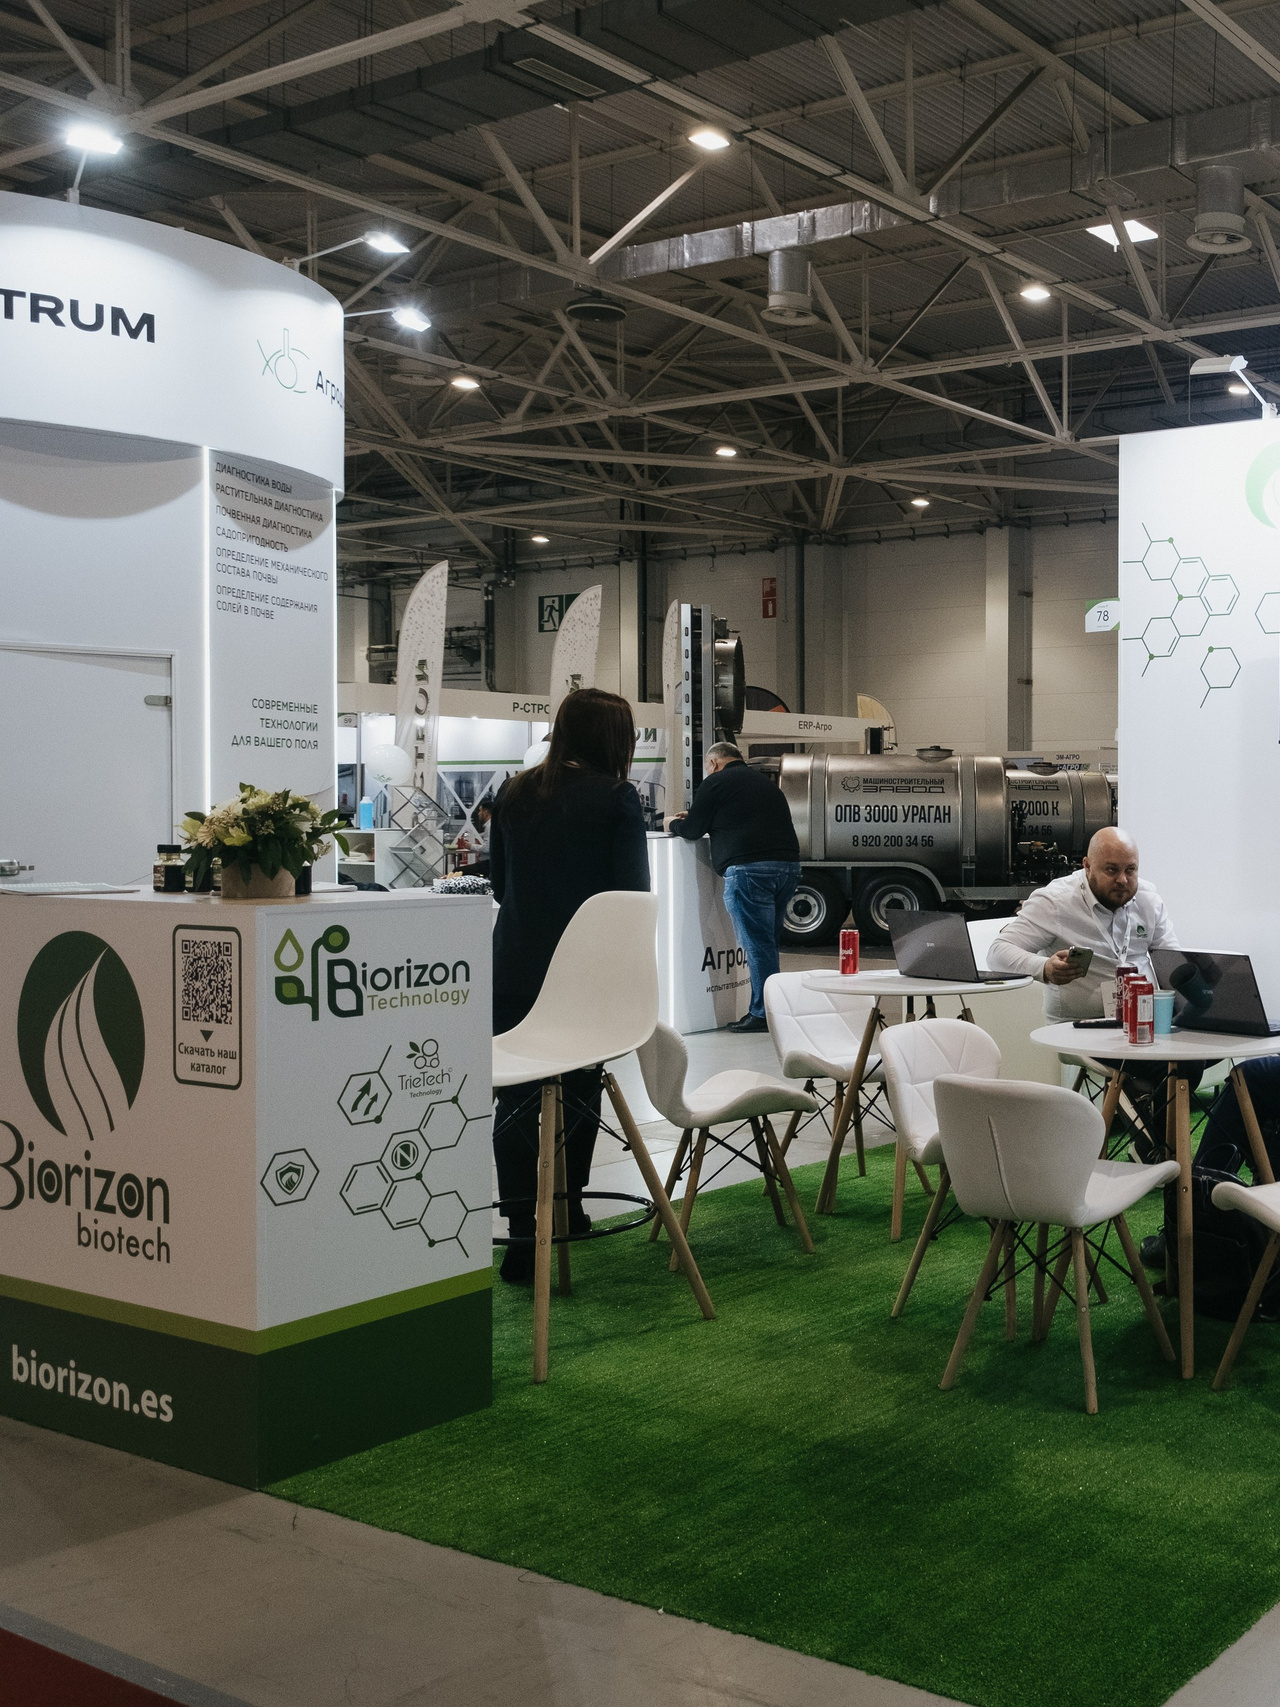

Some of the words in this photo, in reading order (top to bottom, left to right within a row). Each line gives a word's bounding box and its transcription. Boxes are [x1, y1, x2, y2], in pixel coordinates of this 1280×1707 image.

[216, 462, 269, 486] ДИАГНОСТИКА
[272, 479, 292, 494] ВОДЫ
[216, 483, 272, 507] РАСТИТЕЛЬНАЯ
[274, 498, 324, 522] ДИАГНОСТИКА
[216, 505, 260, 525] ПОЧВЕННАЯ
[262, 518, 312, 539] ДИАГНОСТИКА
[216, 526, 288, 552] САДОПРИГОДНОСТЬ
[216, 547, 269, 568] ОПРЕДЕЛЕНИЕ
[271, 558, 328, 582] МЕХАНИЧЕСКОГО
[216, 562, 250, 579] СОСТАВА
[253, 570, 278, 584] ПОЧВЫ
[216, 585, 269, 605] ОПРЕДЕЛЕНИЕ
[271, 596, 318, 613] СОДЕРЖАНИЯ
[216, 600, 242, 614] СОЛЕЙ
[244, 605, 250, 615] В
[251, 606, 274, 620] ПОЧВЕ
[1096, 610, 1110, 622] 78
[252, 698, 318, 714] СОВРЕМЕННЫЕ
[260, 718, 318, 732] ТЕХНОЛОГИИ
[798, 720, 832, 732] ERP-Агро
[232, 735, 252, 746] ДЛЯ
[254, 736, 292, 748] ВАШЕГО
[294, 739, 318, 750] ПОЛЯ
[862, 778, 945, 786] МАШИНОСТРОИТЕЛЬНЫЙ
[862, 786, 946, 794] ЗАВОД
[835, 804, 860, 823] ОПВ
[864, 804, 898, 823] 3000
[902, 804, 952, 824] УРАГАН
[1052, 801, 1060, 816] К
[852, 835, 860, 847] 8
[862, 835, 881, 847] 920
[884, 835, 903, 847] 200
[906, 836, 918, 847] 34
[921, 836, 934, 847] 56
[327, 958, 470, 1018] Biorizon
[367, 988, 470, 1012] Technology
[178, 1042, 216, 1058] Скачать
[217, 1049, 237, 1060] наш
[190, 1062, 226, 1076] каталог
[410, 1089, 442, 1098] Technology
[78, 1212, 170, 1264] biotech
[12, 1344, 174, 1422] biorizon.es
